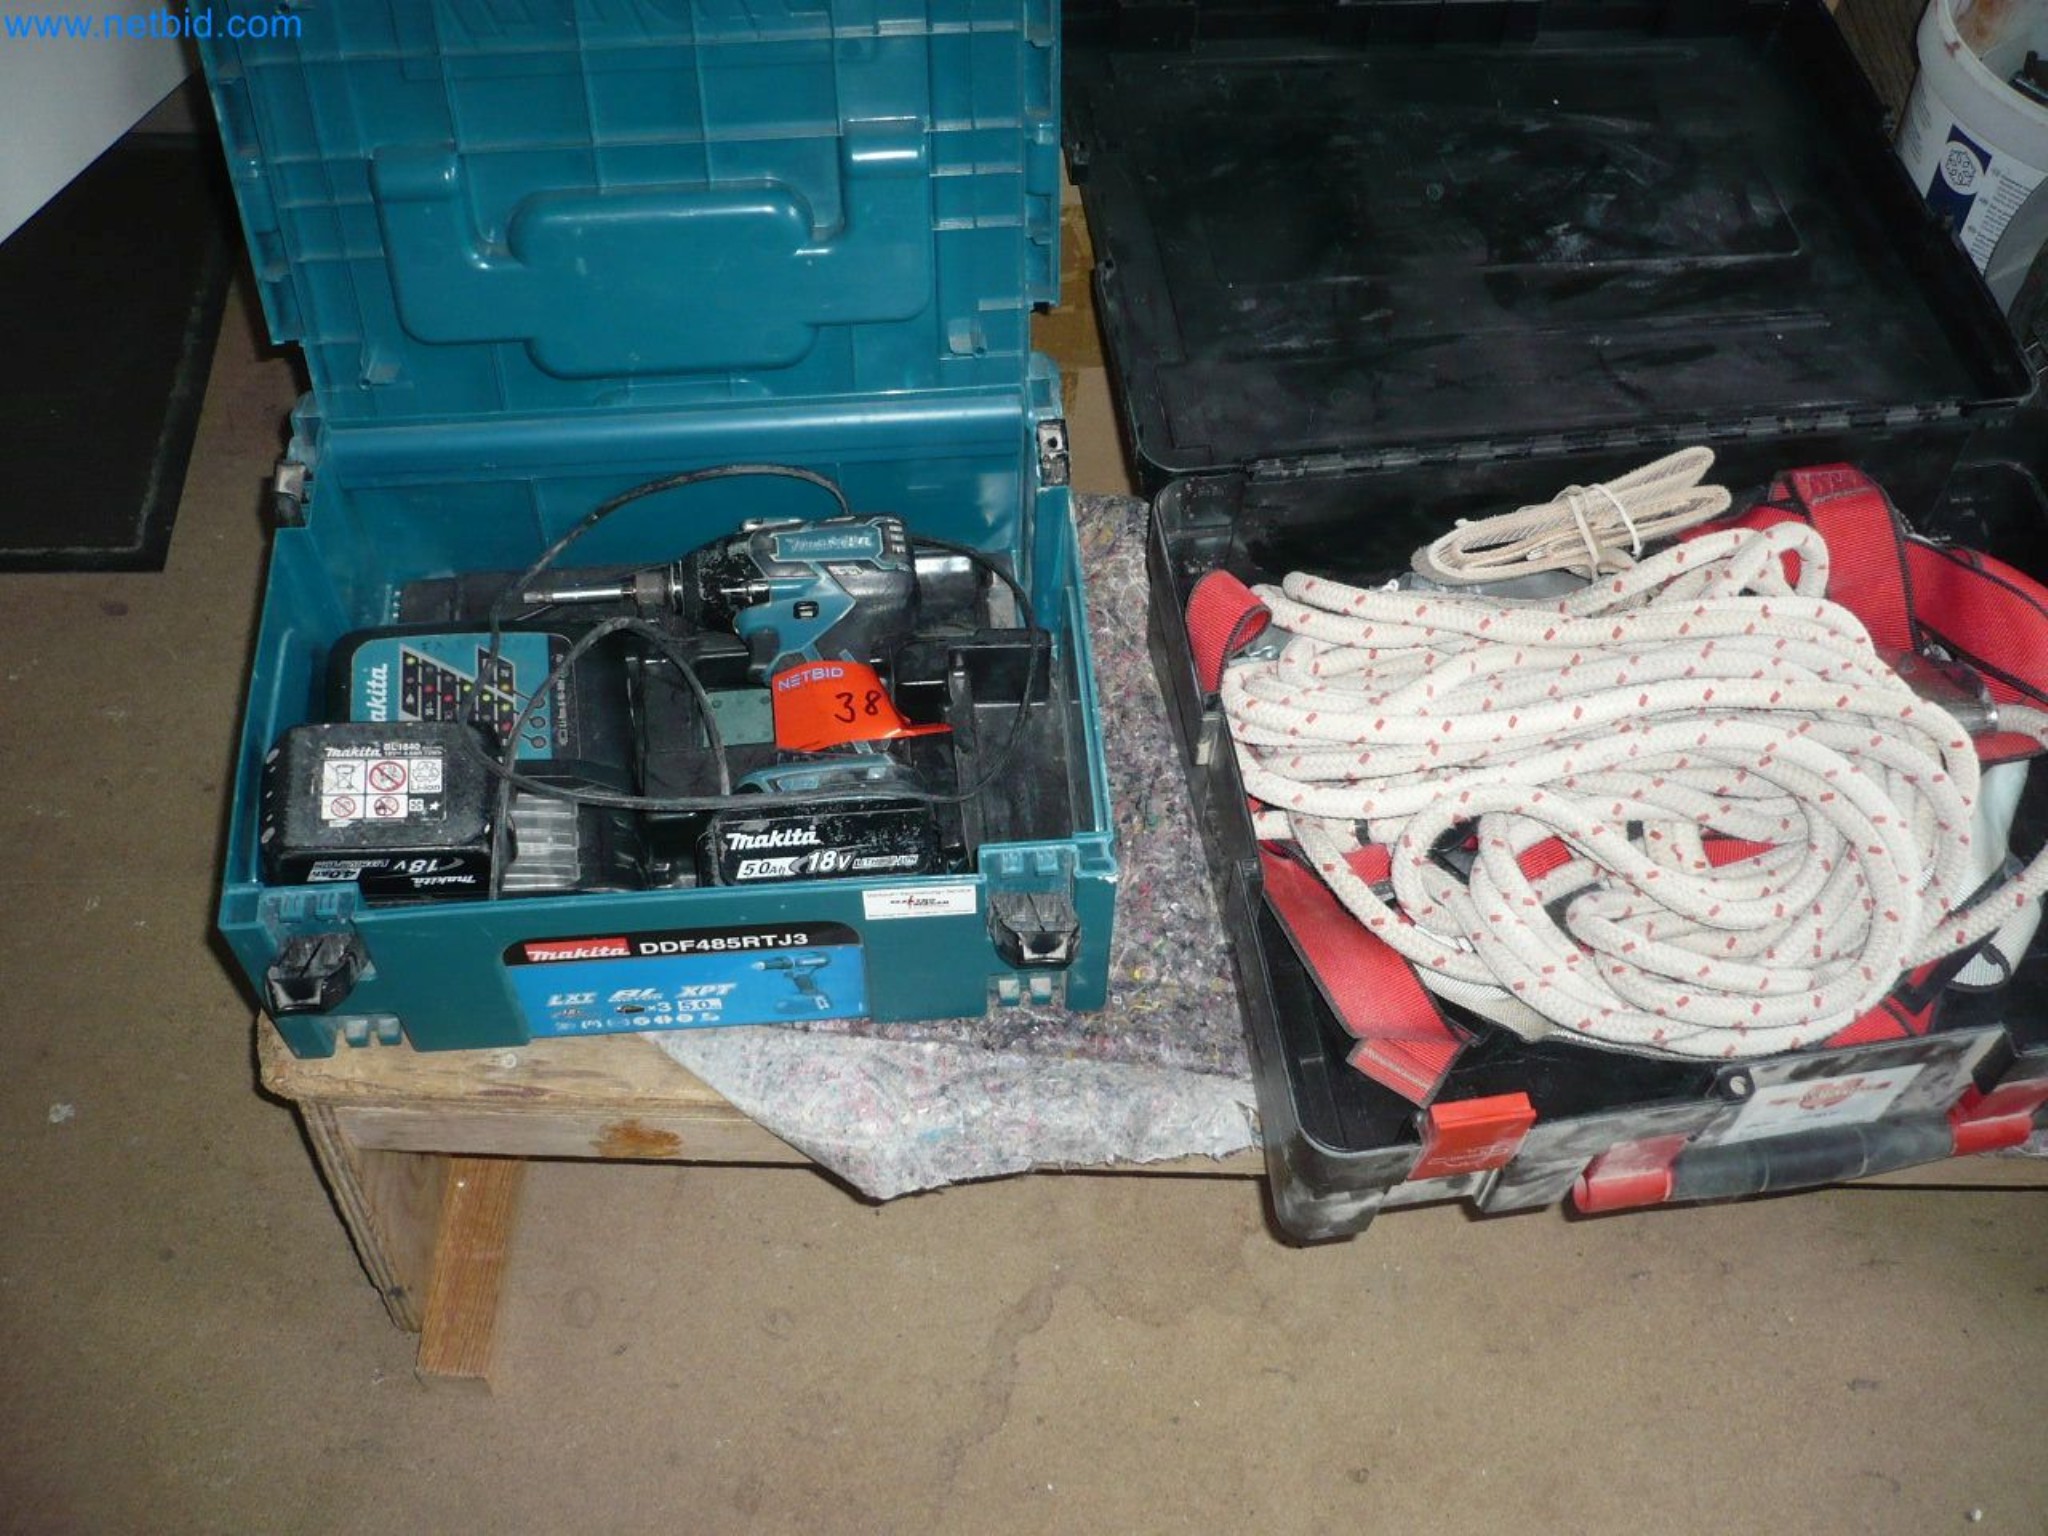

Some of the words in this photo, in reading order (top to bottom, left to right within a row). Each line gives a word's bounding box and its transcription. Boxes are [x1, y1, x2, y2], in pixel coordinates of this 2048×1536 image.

[778, 667, 844, 691] NETBID
[364, 664, 388, 722] akita
[834, 690, 882, 723] 38
[324, 745, 382, 758] makita
[726, 825, 823, 850] makita
[393, 858, 439, 875] 18V
[807, 850, 853, 874] 18V
[411, 875, 476, 889] makita
[527, 946, 631, 962] makita
[639, 933, 808, 955] DDF485RTJ3
[548, 992, 596, 1006] LXT
[675, 983, 736, 998] XPT
